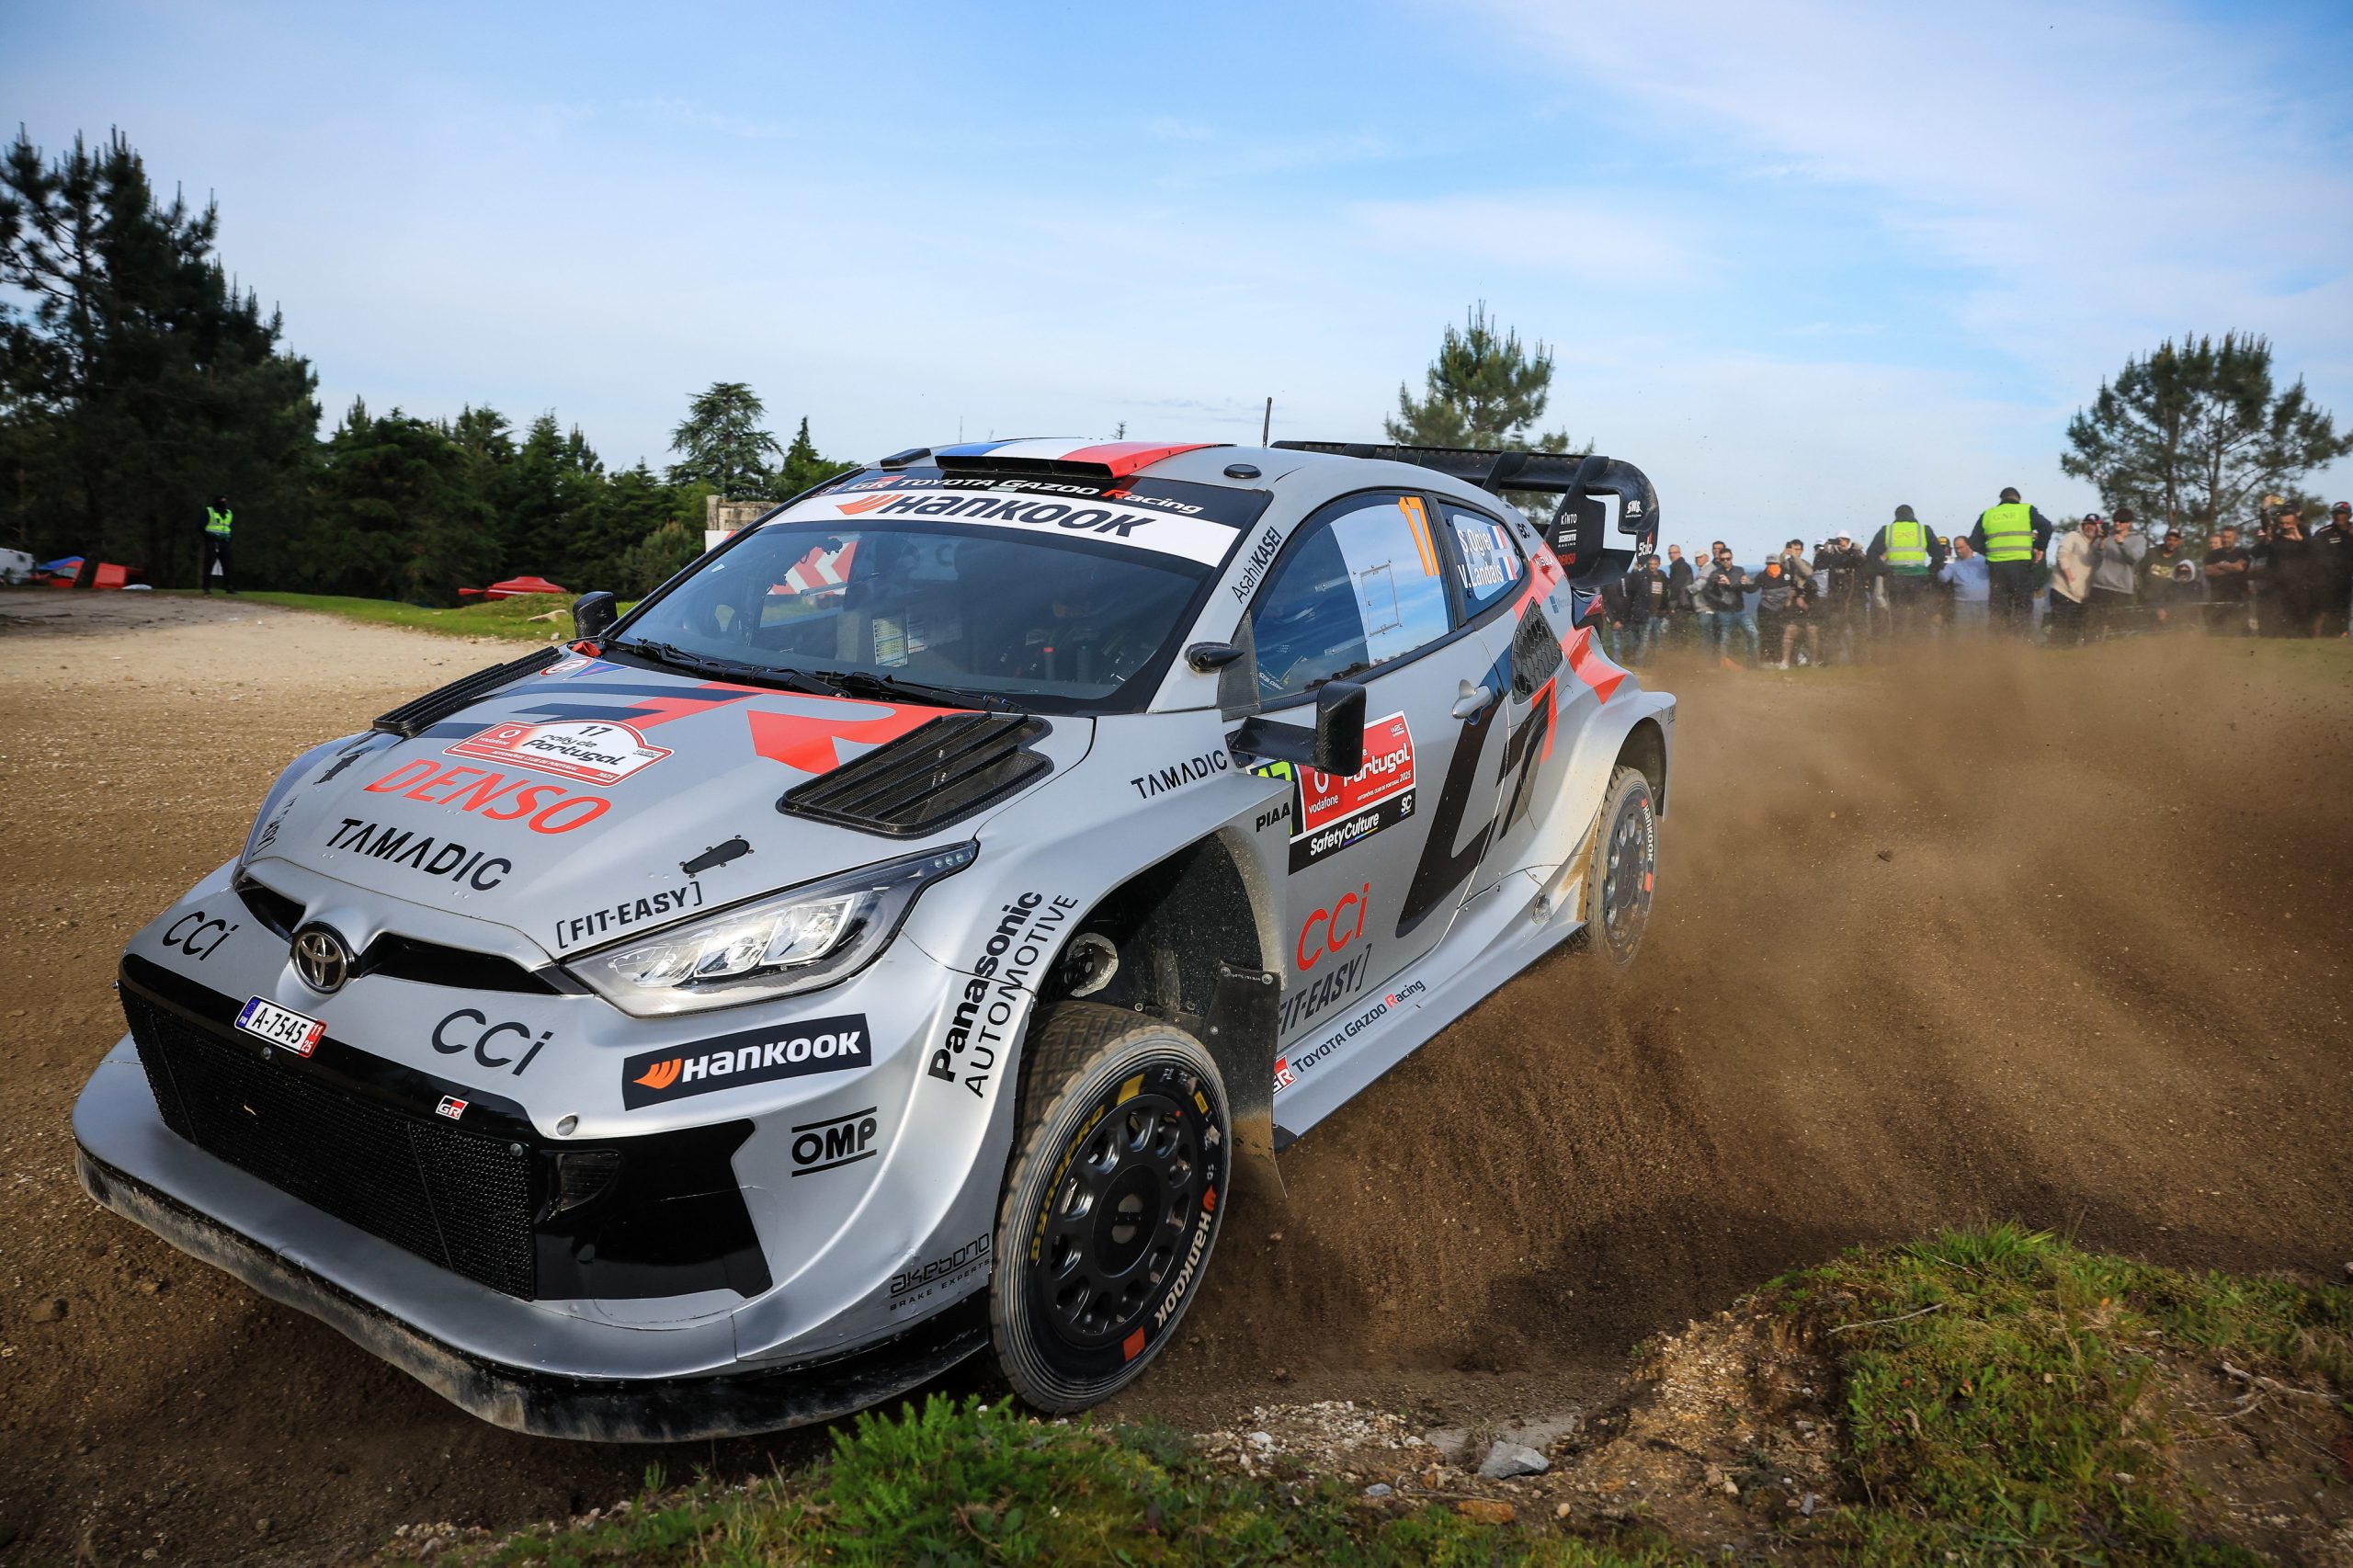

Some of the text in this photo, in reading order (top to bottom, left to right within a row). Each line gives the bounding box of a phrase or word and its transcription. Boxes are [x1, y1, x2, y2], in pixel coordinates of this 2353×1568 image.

[898, 479, 995, 487] TOYOTA
[999, 480, 1100, 495] GAZOO
[1101, 489, 1205, 514] Racing
[1398, 496, 1441, 577] 17
[576, 740, 597, 748] de
[578, 726, 614, 736] 17
[364, 758, 612, 835] DENSO
[1131, 749, 1228, 800] TAMADIC
[1399, 770, 1412, 783] 2025
[1256, 801, 1291, 833] PIAA
[1308, 794, 1339, 814] vodafone
[1401, 794, 1412, 812] SC
[326, 817, 512, 892] TAMADIC
[1310, 812, 1380, 856] SafetyCulture
[162, 910, 240, 961] CCi
[1296, 881, 1370, 971] CCi
[927, 891, 1043, 1083] Panasonic
[964, 894, 1079, 1099] AUTOMOTIVE
[251, 1007, 308, 1044] A-7545
[301, 1040, 313, 1053] 25
[311, 1024, 324, 1037] 11
[431, 1007, 554, 1076] CCi
[1291, 1033, 1347, 1073] TOYOTA
[1344, 1003, 1388, 1038] GAZOO
[1384, 980, 1427, 1008] Racing
[791, 1117, 878, 1166] OMP
[890, 1259, 990, 1311] BRAKE EXPERTS
